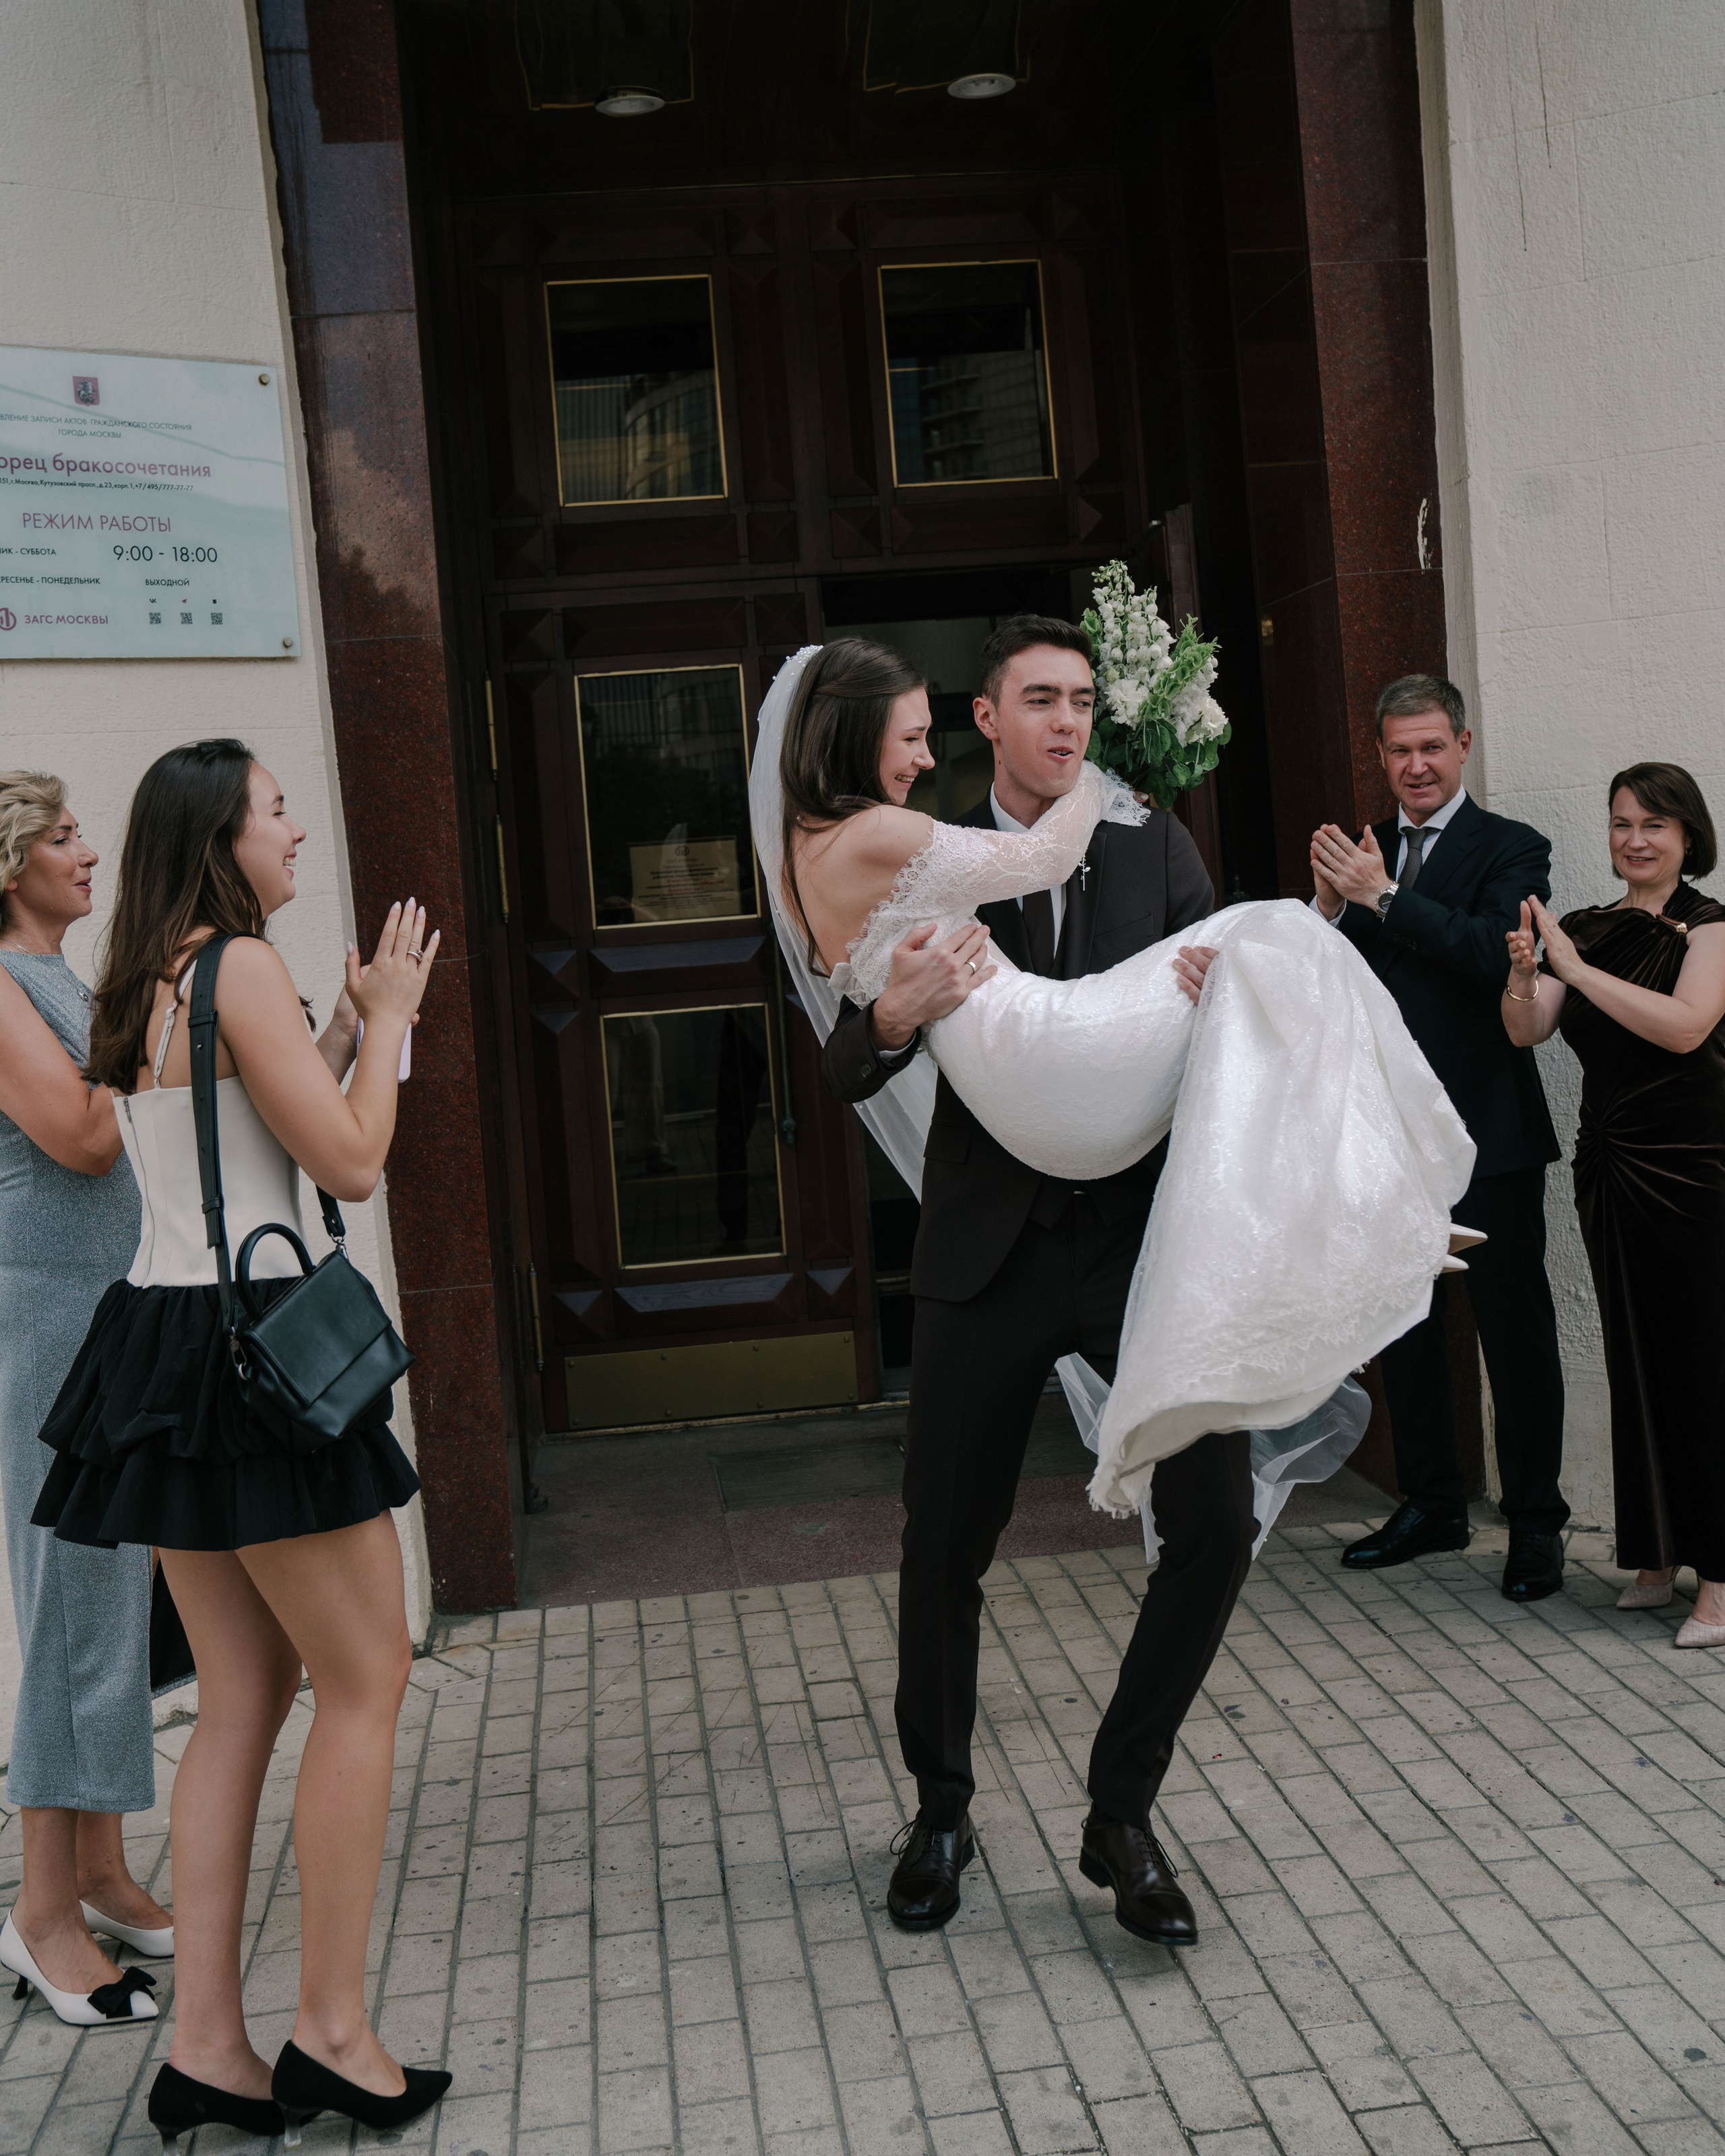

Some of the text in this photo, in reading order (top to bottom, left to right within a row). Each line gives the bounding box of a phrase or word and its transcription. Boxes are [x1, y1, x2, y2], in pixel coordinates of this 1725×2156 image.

[91, 419, 147, 429] ГРАЖДАНСКОГО
[149, 422, 192, 431] СОСТОЯНИЯ
[59, 429, 88, 437] ГОРОДА
[53, 452, 211, 477] бракосочетания
[22, 513, 170, 532] РЕЖИМ РАБОТЫ
[113, 545, 153, 561] 9:00
[172, 546, 218, 563] 18:00
[41, 577, 100, 585] ПОНЕДЕЛЬНИК
[145, 578, 189, 587] ВЫХОДНОЙ
[24, 614, 108, 625] ЗАГС МОСКВЫ
